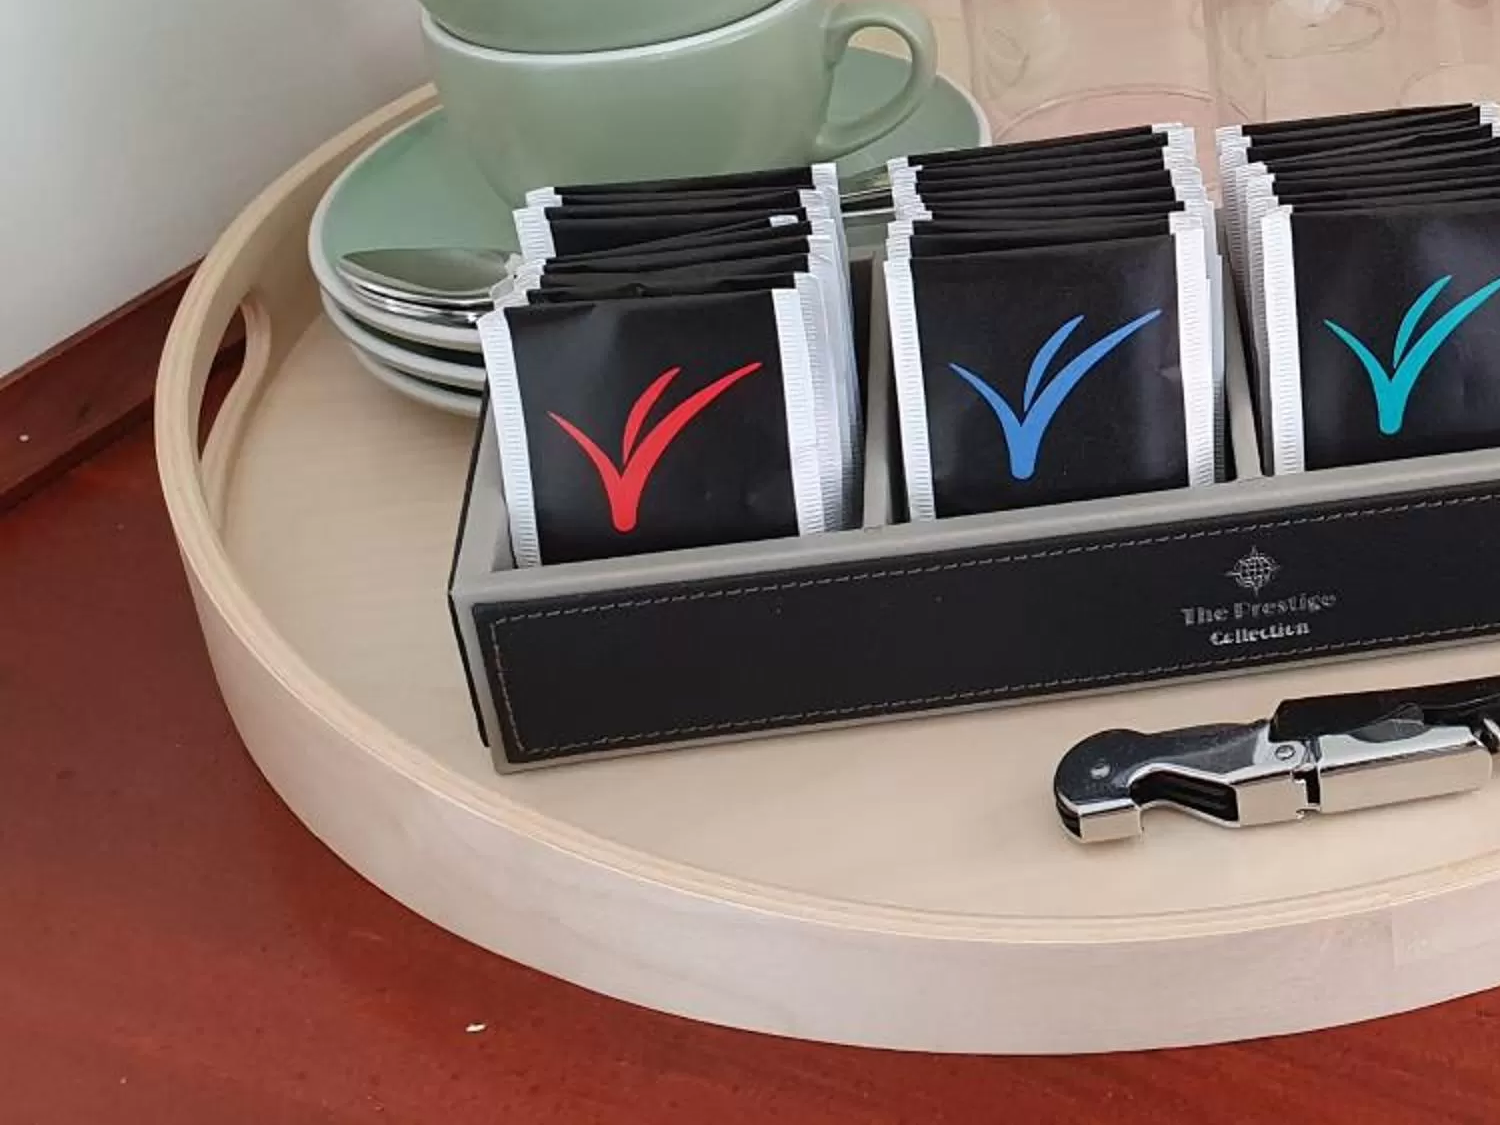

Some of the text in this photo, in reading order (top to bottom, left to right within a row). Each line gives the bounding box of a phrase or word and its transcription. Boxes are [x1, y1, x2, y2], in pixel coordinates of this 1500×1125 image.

[1181, 593, 1337, 625] The Prestige
[1210, 622, 1310, 645] Collection
